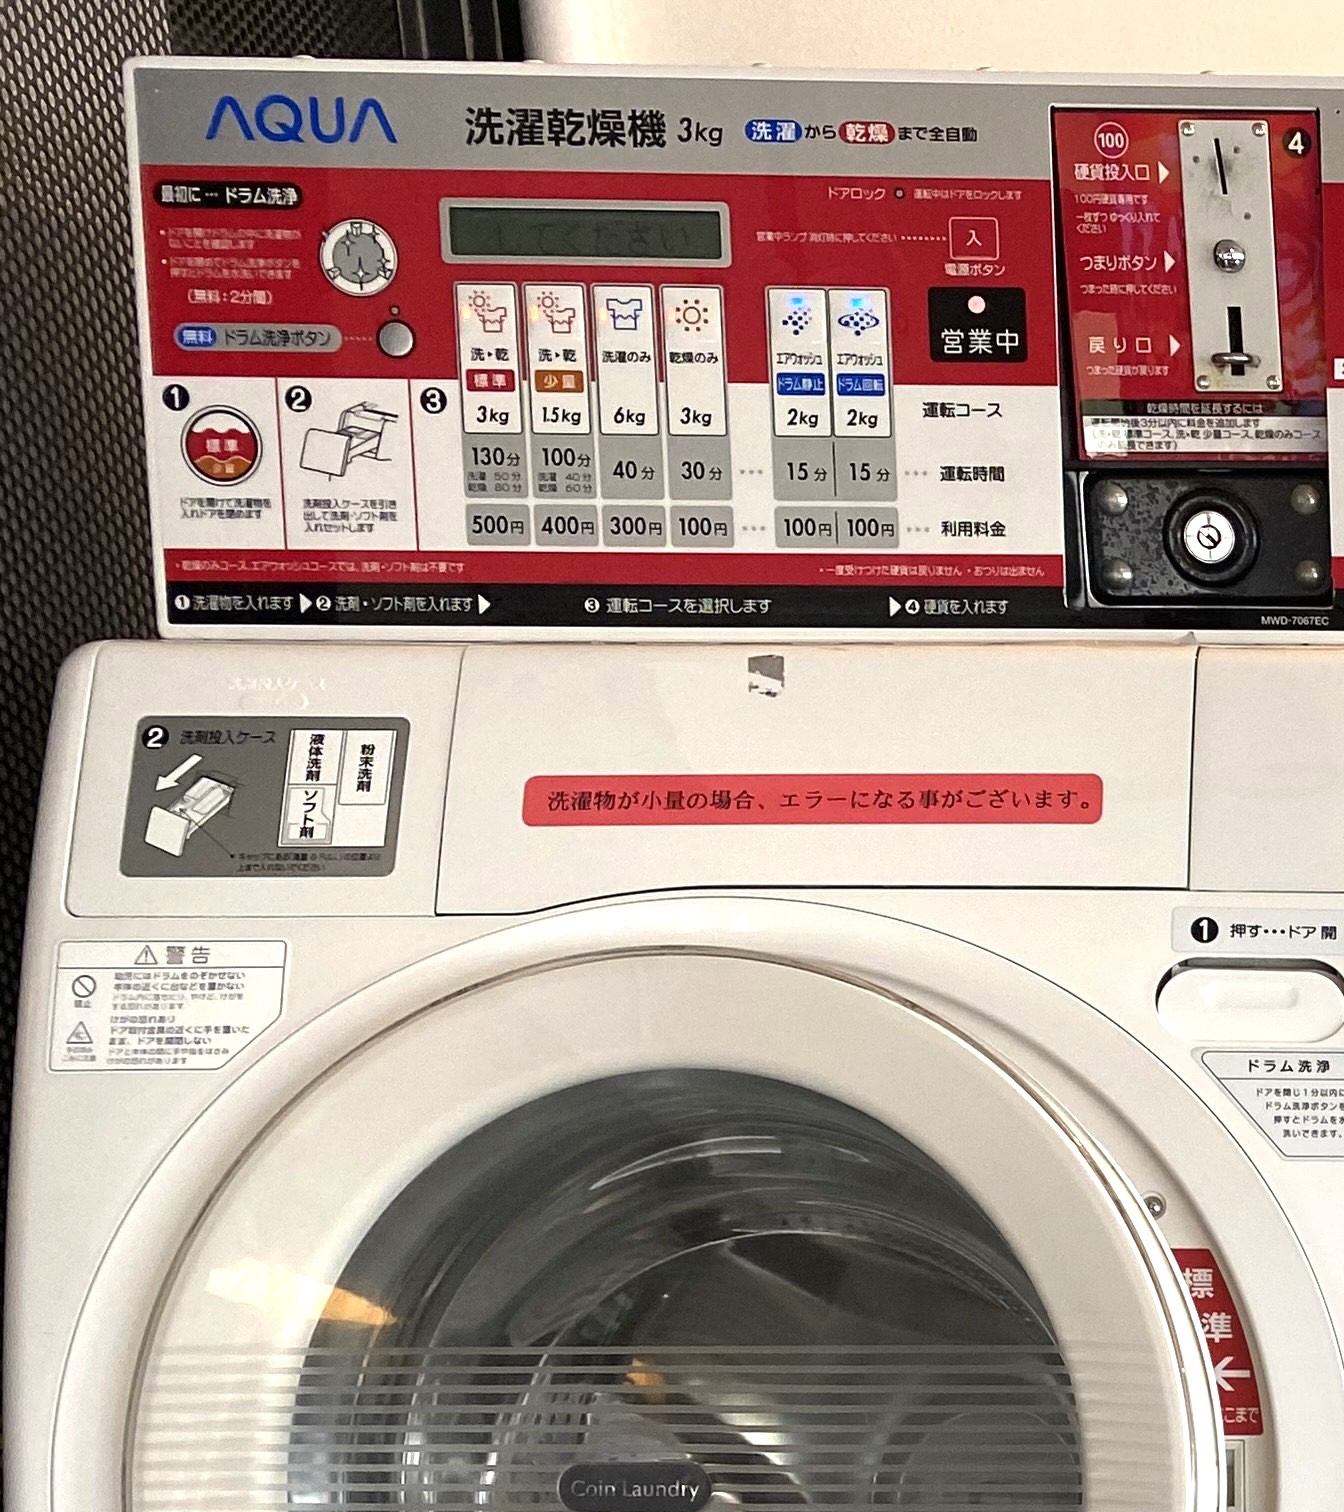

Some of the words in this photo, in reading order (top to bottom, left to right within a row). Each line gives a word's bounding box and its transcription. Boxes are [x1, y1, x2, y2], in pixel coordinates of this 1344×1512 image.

[206, 95, 397, 144] AQUA
[465, 107, 667, 150] 洗濯乾燥機
[677, 117, 723, 147] 3kg
[1074, 164, 1150, 181] 硬貨投入口
[828, 187, 885, 200] ドアロック
[945, 264, 1005, 275] 電源ボタン
[1080, 255, 1157, 270] つまりボタン
[182, 330, 213, 343] 無料
[225, 330, 330, 347] ドラム洗浄ボタン
[941, 329, 1018, 354] 営業中
[602, 351, 650, 364] 洗濯のみ
[670, 352, 718, 364] 乾燥のみ
[543, 375, 576, 388] 少量
[838, 378, 884, 392] ドラム回転
[787, 409, 818, 428] 2kg
[847, 409, 878, 428] 2kg
[923, 403, 1002, 418] 運転コース
[472, 447, 520, 466] 130分
[543, 448, 591, 467] 100分
[940, 466, 1004, 482] 運転時間
[472, 516, 524, 535] 500円
[542, 517, 594, 535] 400円
[610, 517, 662, 536] 300円
[679, 517, 727, 536] 100円
[784, 518, 831, 537] 100円
[848, 519, 894, 537] 100円
[941, 521, 1006, 537] 利用料金
[1261, 616, 1329, 626] MWD-7067EC
[181, 730, 276, 745] 洗剤投入ケース
[305, 734, 325, 782] 液体洗剤
[357, 744, 376, 793] 粉末洗剤
[548, 790, 1092, 811] 洗濯物が小量の場合、エラーになる事がございます。
[299, 789, 315, 839] ソフト剤
[166, 946, 210, 964] 警告
[1248, 1060, 1330, 1073] ドラム洗浄
[571, 1480, 615, 1496] Coin
[623, 1480, 699, 1502] Laundry
